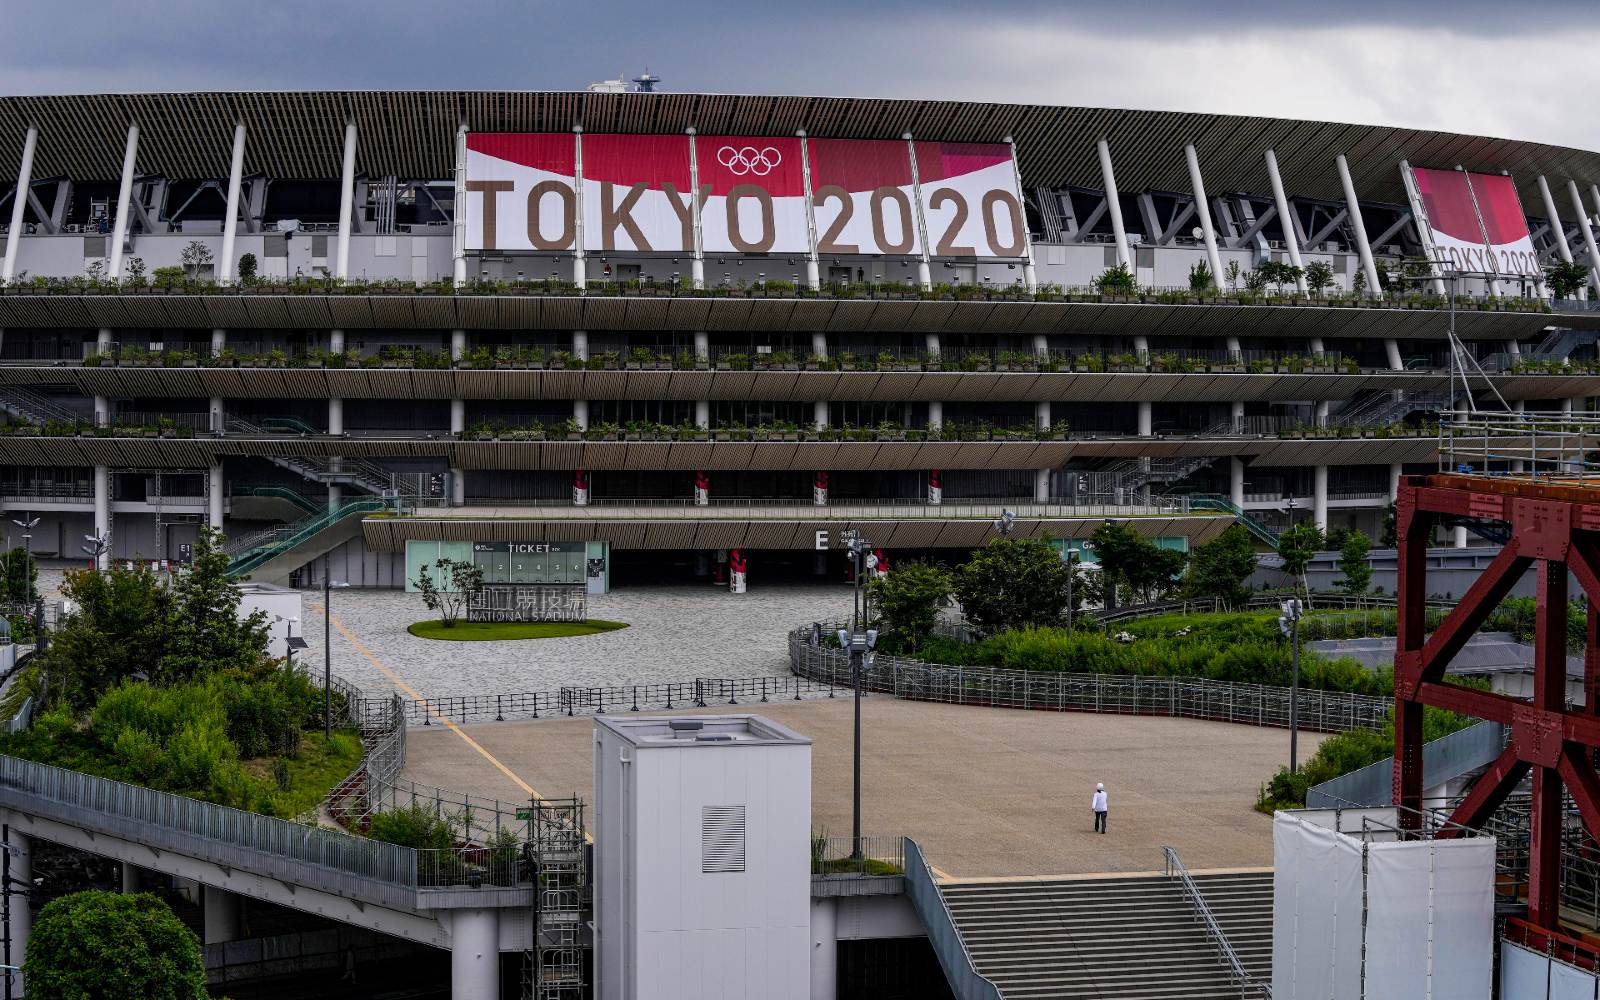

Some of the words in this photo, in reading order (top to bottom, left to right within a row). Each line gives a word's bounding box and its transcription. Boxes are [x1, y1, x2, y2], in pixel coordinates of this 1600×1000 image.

[465, 180, 775, 253] TOKYO
[813, 185, 1026, 257] 2020
[1437, 246, 1500, 273] TOKYO
[1501, 250, 1540, 276] 2020
[815, 530, 829, 550] E
[180, 544, 190, 552] E1
[508, 544, 550, 553] TICKET
[469, 611, 528, 622] NATIONAL
[530, 611, 585, 622] STADIUM
